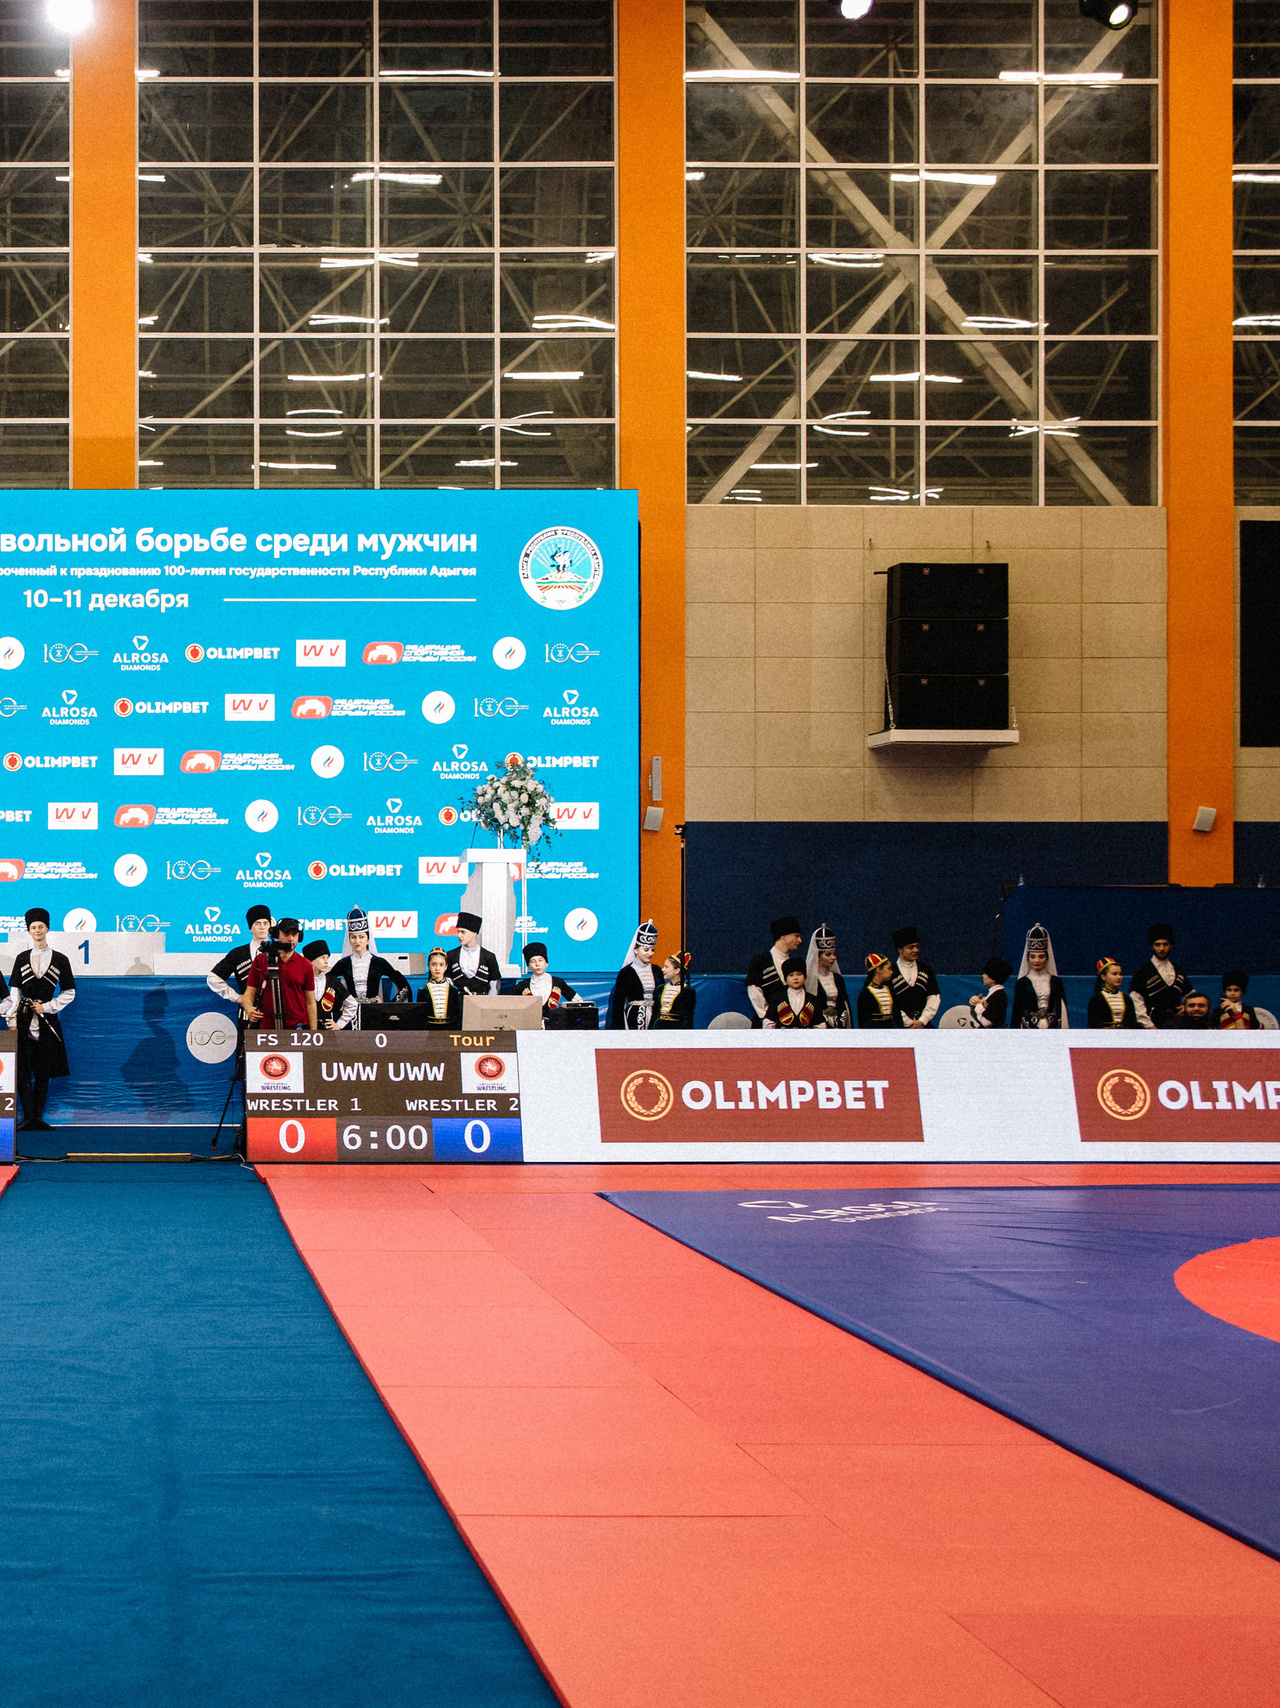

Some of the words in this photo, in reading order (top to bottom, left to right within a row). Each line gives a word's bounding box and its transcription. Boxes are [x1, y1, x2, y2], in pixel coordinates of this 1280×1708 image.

[0, 527, 126, 552] вольной
[136, 527, 247, 558] борьбе
[256, 533, 348, 558] среди
[358, 534, 477, 560] мужчин
[70, 567, 161, 578] празднованию
[164, 565, 226, 575] 100-летия
[229, 567, 350, 579] государственности
[353, 565, 427, 579] Республики
[430, 565, 476, 577] Адыгея
[89, 589, 188, 613] декабря
[112, 652, 169, 663] ALROSA
[206, 647, 280, 659] OLIMPBET
[41, 706, 98, 717] ALROSA
[135, 702, 209, 714] OLIMPBET
[543, 706, 600, 717] ALROSA
[24, 756, 98, 768] OLIMPBET
[432, 761, 489, 772] ALROSA
[366, 815, 423, 826] ALROSA
[235, 869, 292, 880] ALROSA
[329, 864, 403, 876] OLIMPBET
[185, 924, 242, 935] ALROSA
[78, 940, 90, 965] 1
[257, 1034, 278, 1046] FS
[290, 1034, 323, 1046] 120
[375, 1034, 387, 1048] 0
[450, 1034, 494, 1046] Tour
[321, 1062, 378, 1081] UWW
[388, 1062, 444, 1081] UWW
[681, 1080, 890, 1110] OLIMPBET
[5, 1098, 14, 1111] 2
[247, 1099, 338, 1111] WRESTLER
[351, 1099, 361, 1111] 1
[406, 1099, 497, 1111] WRESTLER
[509, 1098, 519, 1111] 2
[279, 1120, 306, 1153] 0
[342, 1125, 428, 1150] 6:00
[464, 1120, 491, 1153] 0
